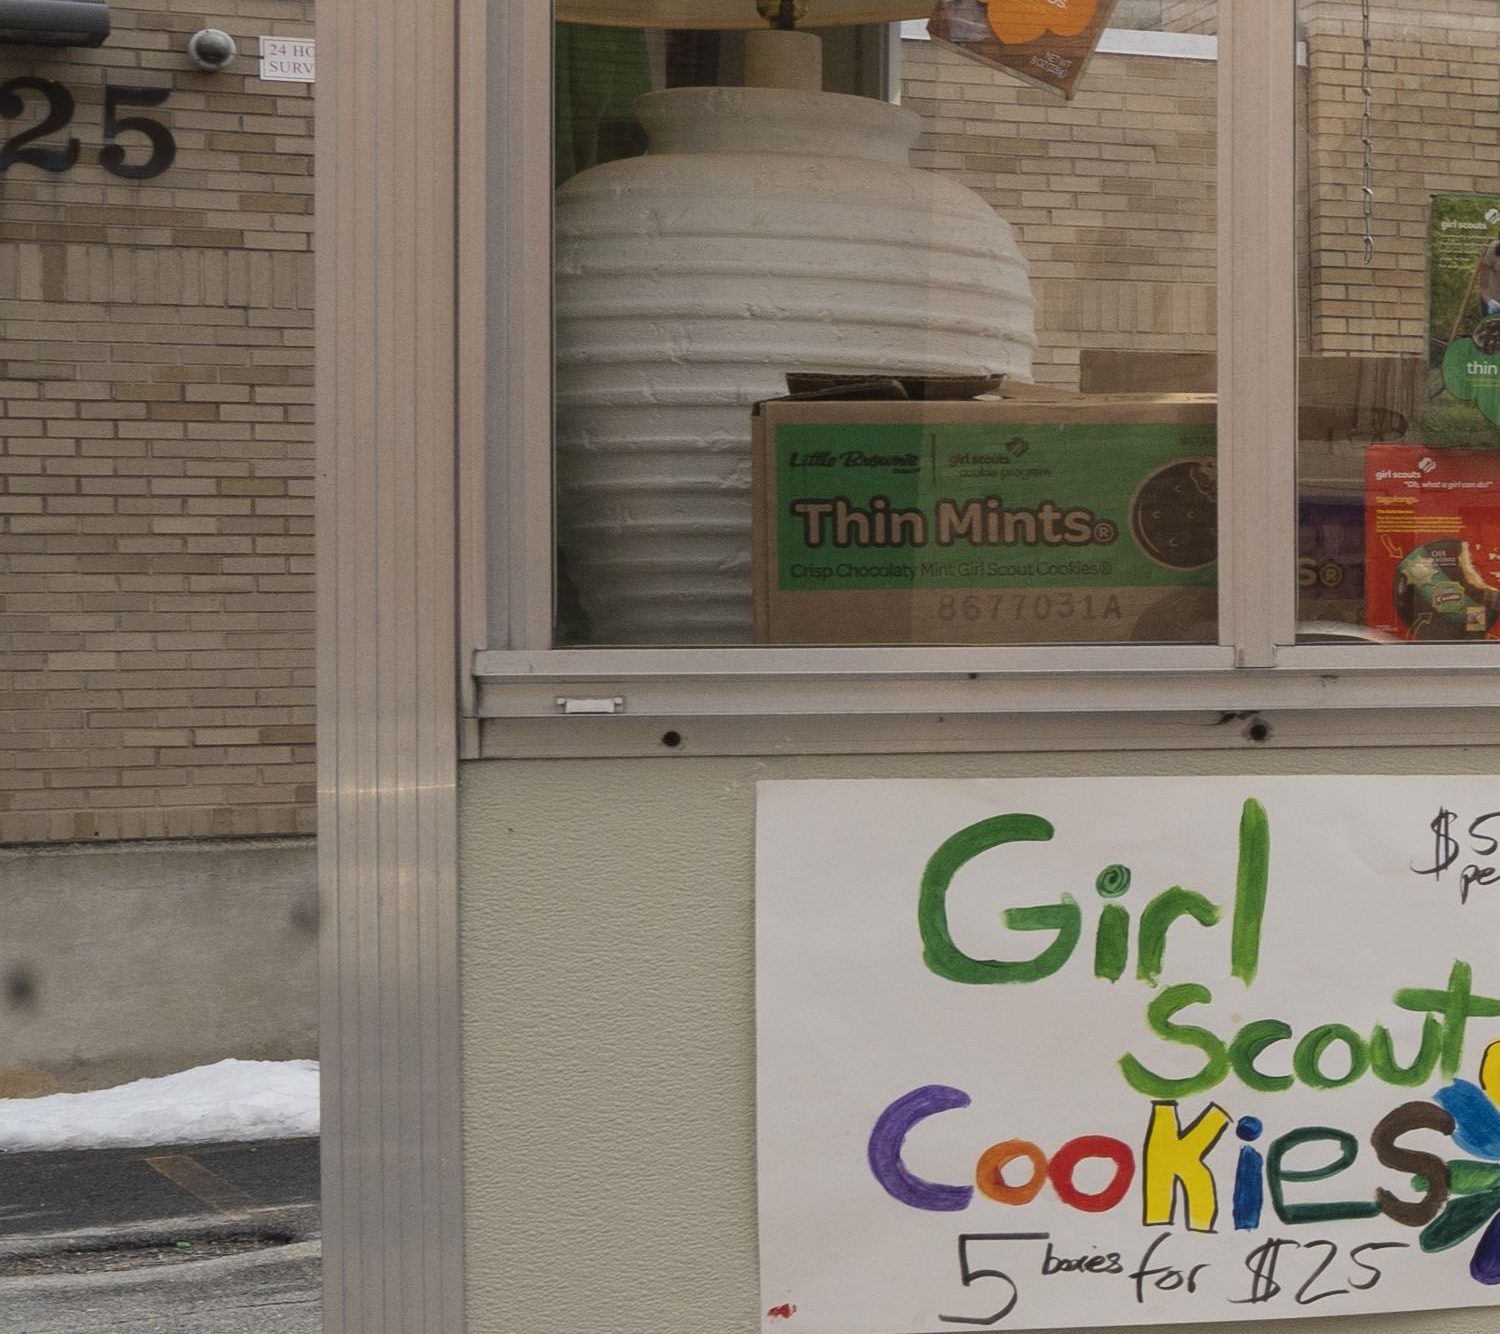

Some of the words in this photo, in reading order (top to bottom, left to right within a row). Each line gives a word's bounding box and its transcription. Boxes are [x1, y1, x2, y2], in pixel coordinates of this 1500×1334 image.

[269, 43, 287, 56] 24
[1466, 361, 1497, 375] thin
[1375, 470, 1391, 481] girl
[1392, 471, 1422, 480] scouts
[790, 494, 927, 548] Thin
[790, 563, 833, 581] Crisp
[836, 563, 916, 581] Chocolaty
[920, 563, 954, 577] Mint
[958, 562, 984, 577] Girl
[987, 562, 1034, 576] Scout
[917, 798, 1271, 986] Girl
[867, 1083, 1457, 1232] Cookies
[938, 1232, 1050, 1326] 5
[1126, 1230, 1208, 1306] for
[1227, 1240, 1411, 1306] $25
